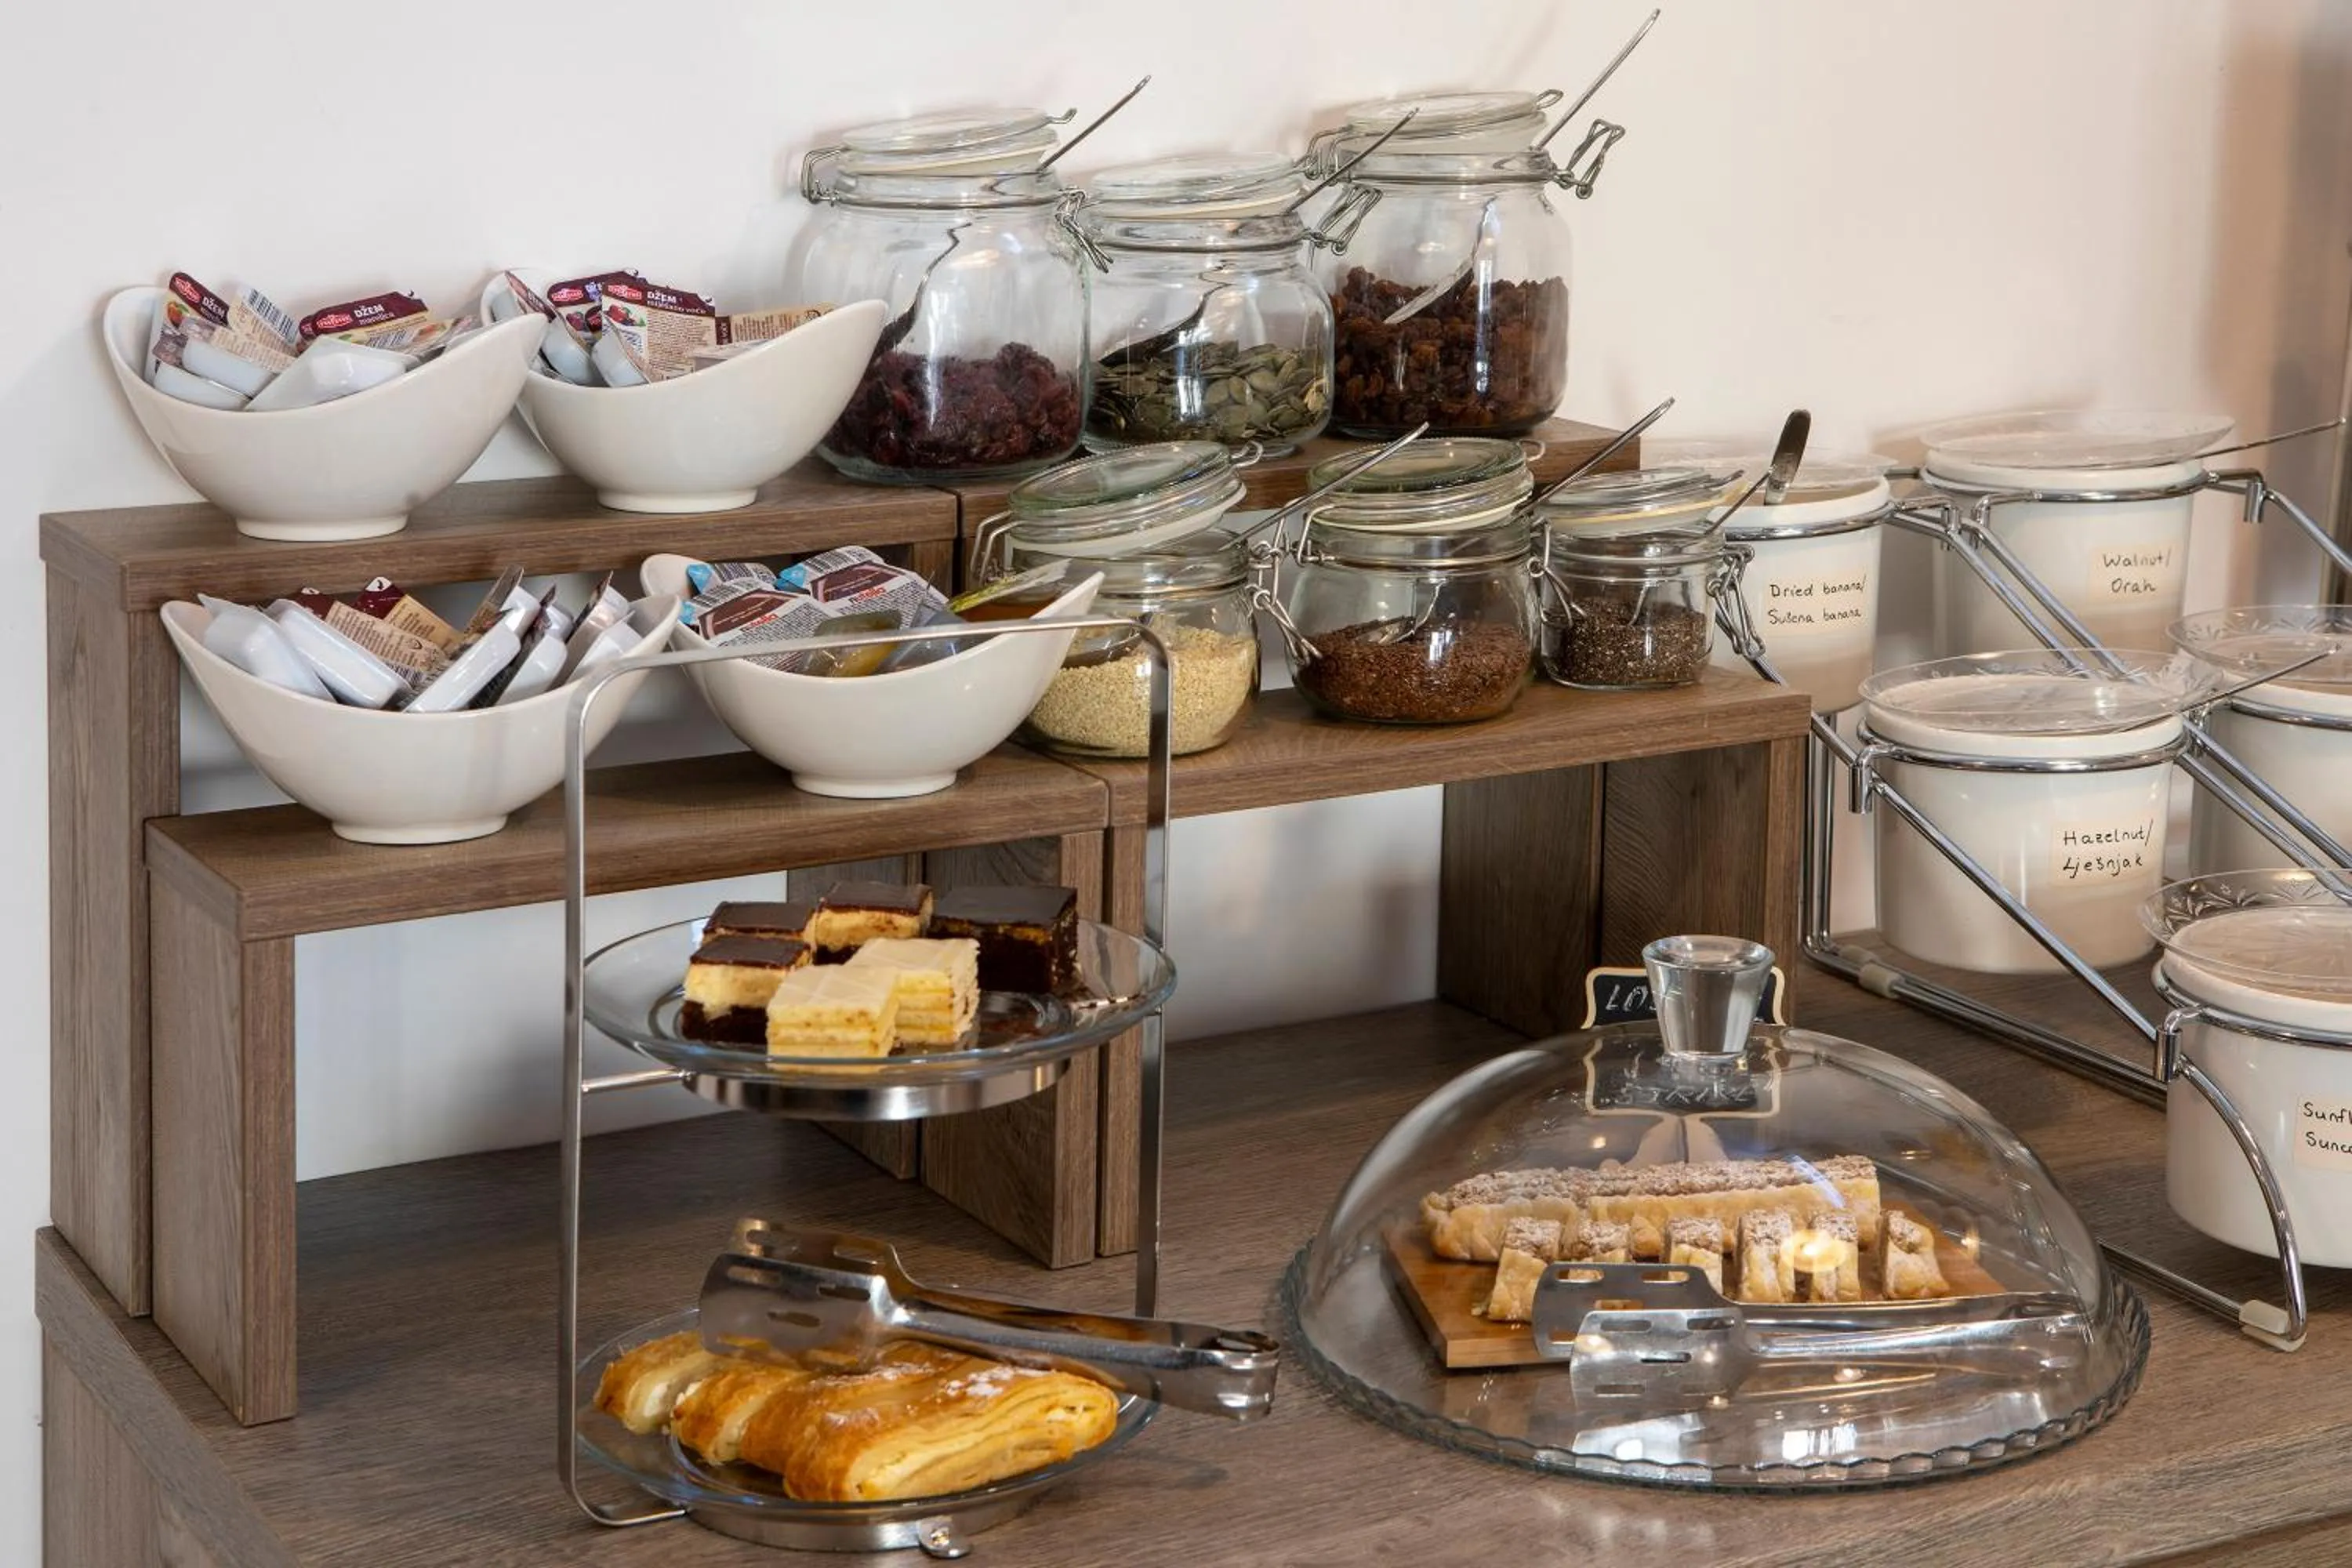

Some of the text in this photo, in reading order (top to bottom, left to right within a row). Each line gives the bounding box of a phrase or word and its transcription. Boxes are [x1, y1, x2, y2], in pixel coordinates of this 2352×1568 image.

[647, 289, 677, 304] DŽEM
[354, 303, 385, 318] DŽEM
[2102, 546, 2172, 568] Walnut/
[1769, 583, 1813, 598] Dried
[2111, 577, 2157, 593] Orah
[1823, 608, 1862, 622] banana
[2063, 818, 2154, 847] Hazelnut/
